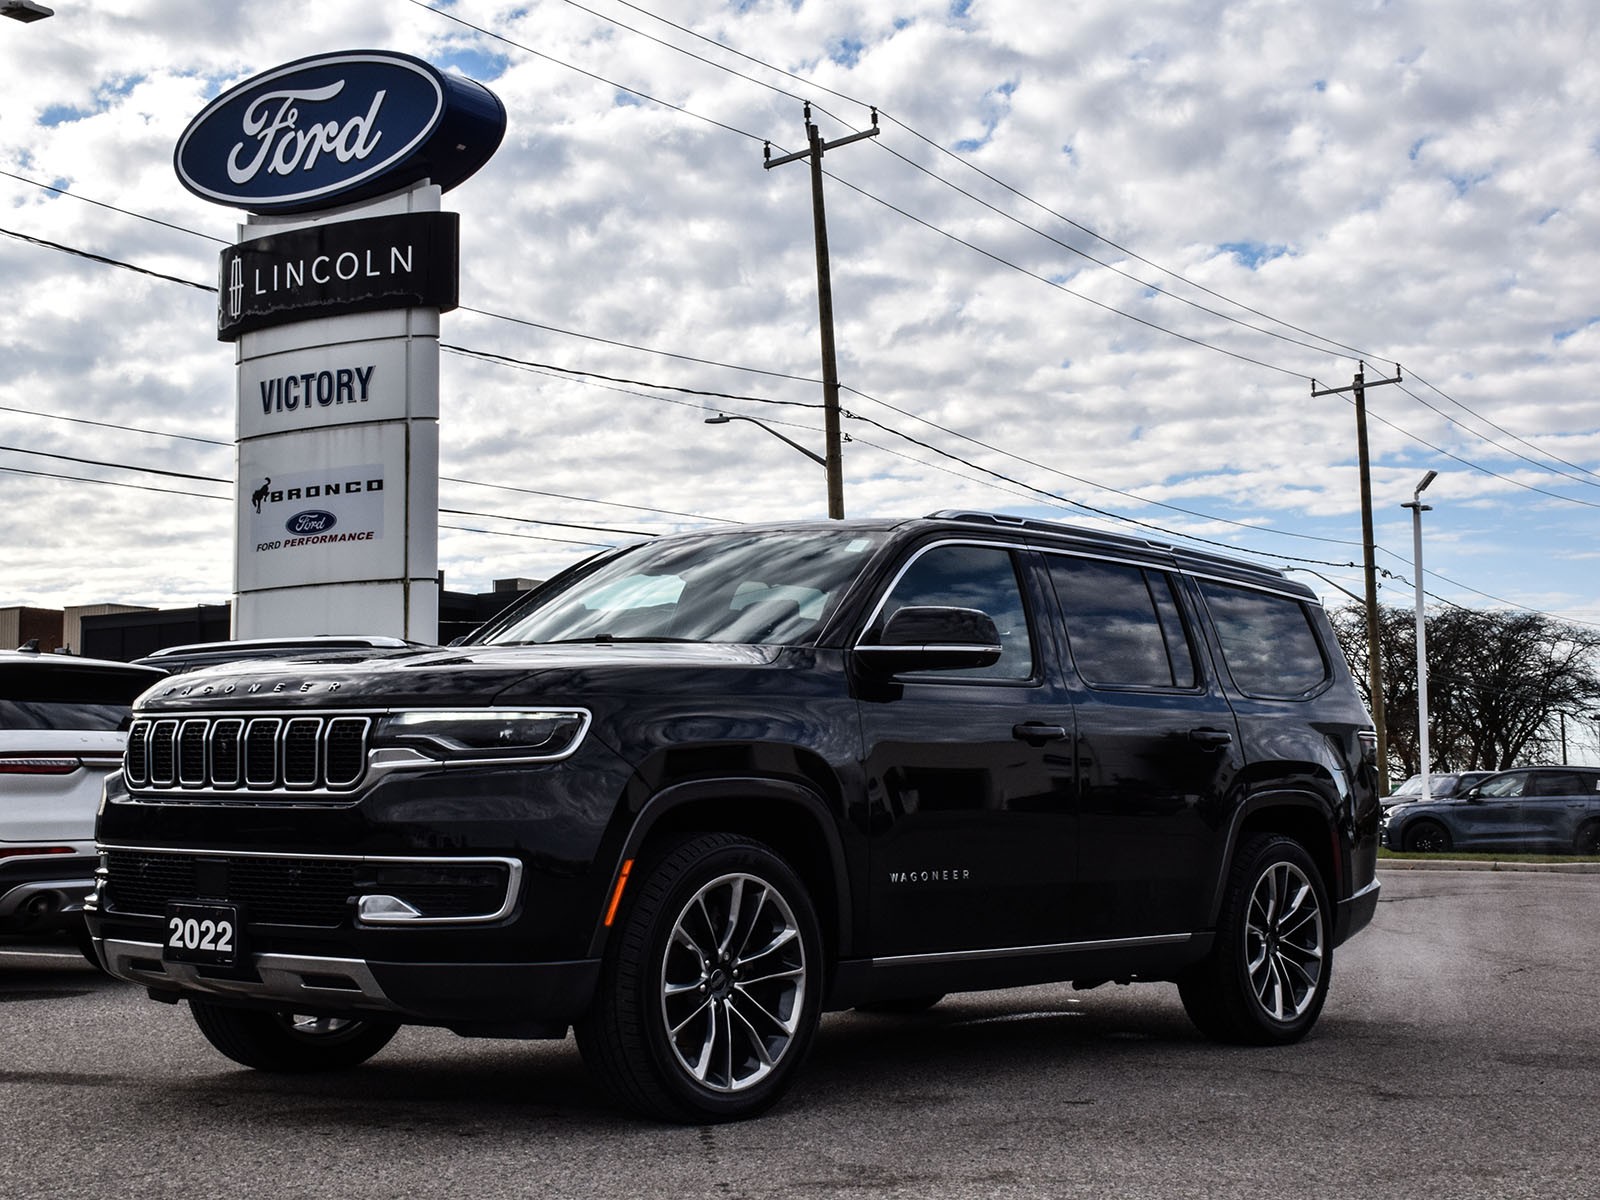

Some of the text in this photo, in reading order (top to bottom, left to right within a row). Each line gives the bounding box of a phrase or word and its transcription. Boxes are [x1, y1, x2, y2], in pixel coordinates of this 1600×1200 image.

[227, 79, 386, 184] Ford
[255, 245, 414, 295] LINCOLN
[260, 365, 376, 414] VICTORY
[270, 479, 383, 503] BRONCO
[295, 514, 325, 531] Ford
[256, 531, 375, 552] FORD PERFORMANCE
[162, 682, 341, 696] WAGONEER
[889, 869, 970, 883] WAGONEER
[168, 917, 233, 952] 2022
